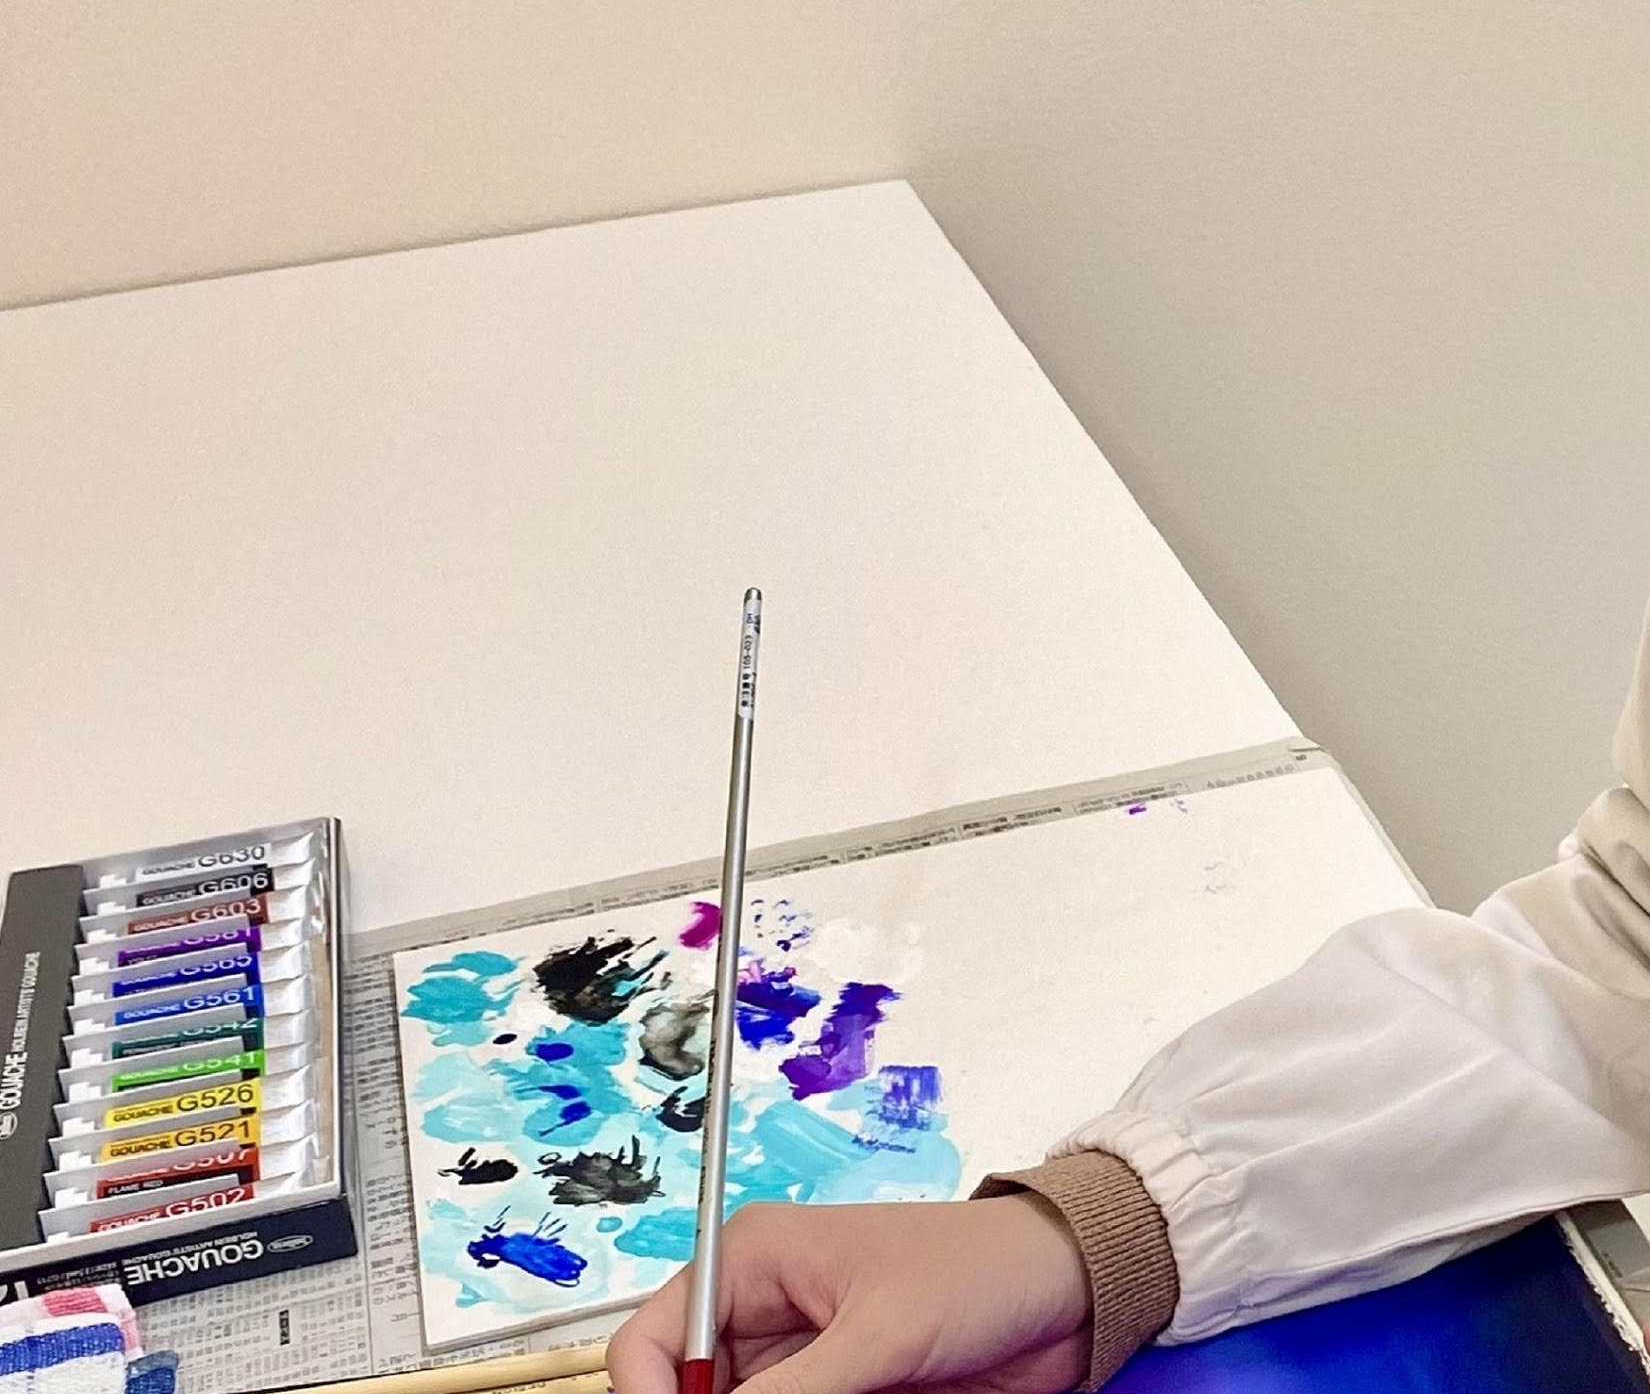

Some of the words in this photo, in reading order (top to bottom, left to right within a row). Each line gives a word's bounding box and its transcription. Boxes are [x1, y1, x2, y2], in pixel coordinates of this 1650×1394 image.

[200, 872, 268, 895] G606
[191, 899, 261, 922] G603
[184, 987, 254, 1009] G561
[177, 1084, 254, 1111] G526
[175, 1121, 249, 1147] G521
[166, 1188, 246, 1218] G502
[123, 1237, 265, 1286] GOUACHE
